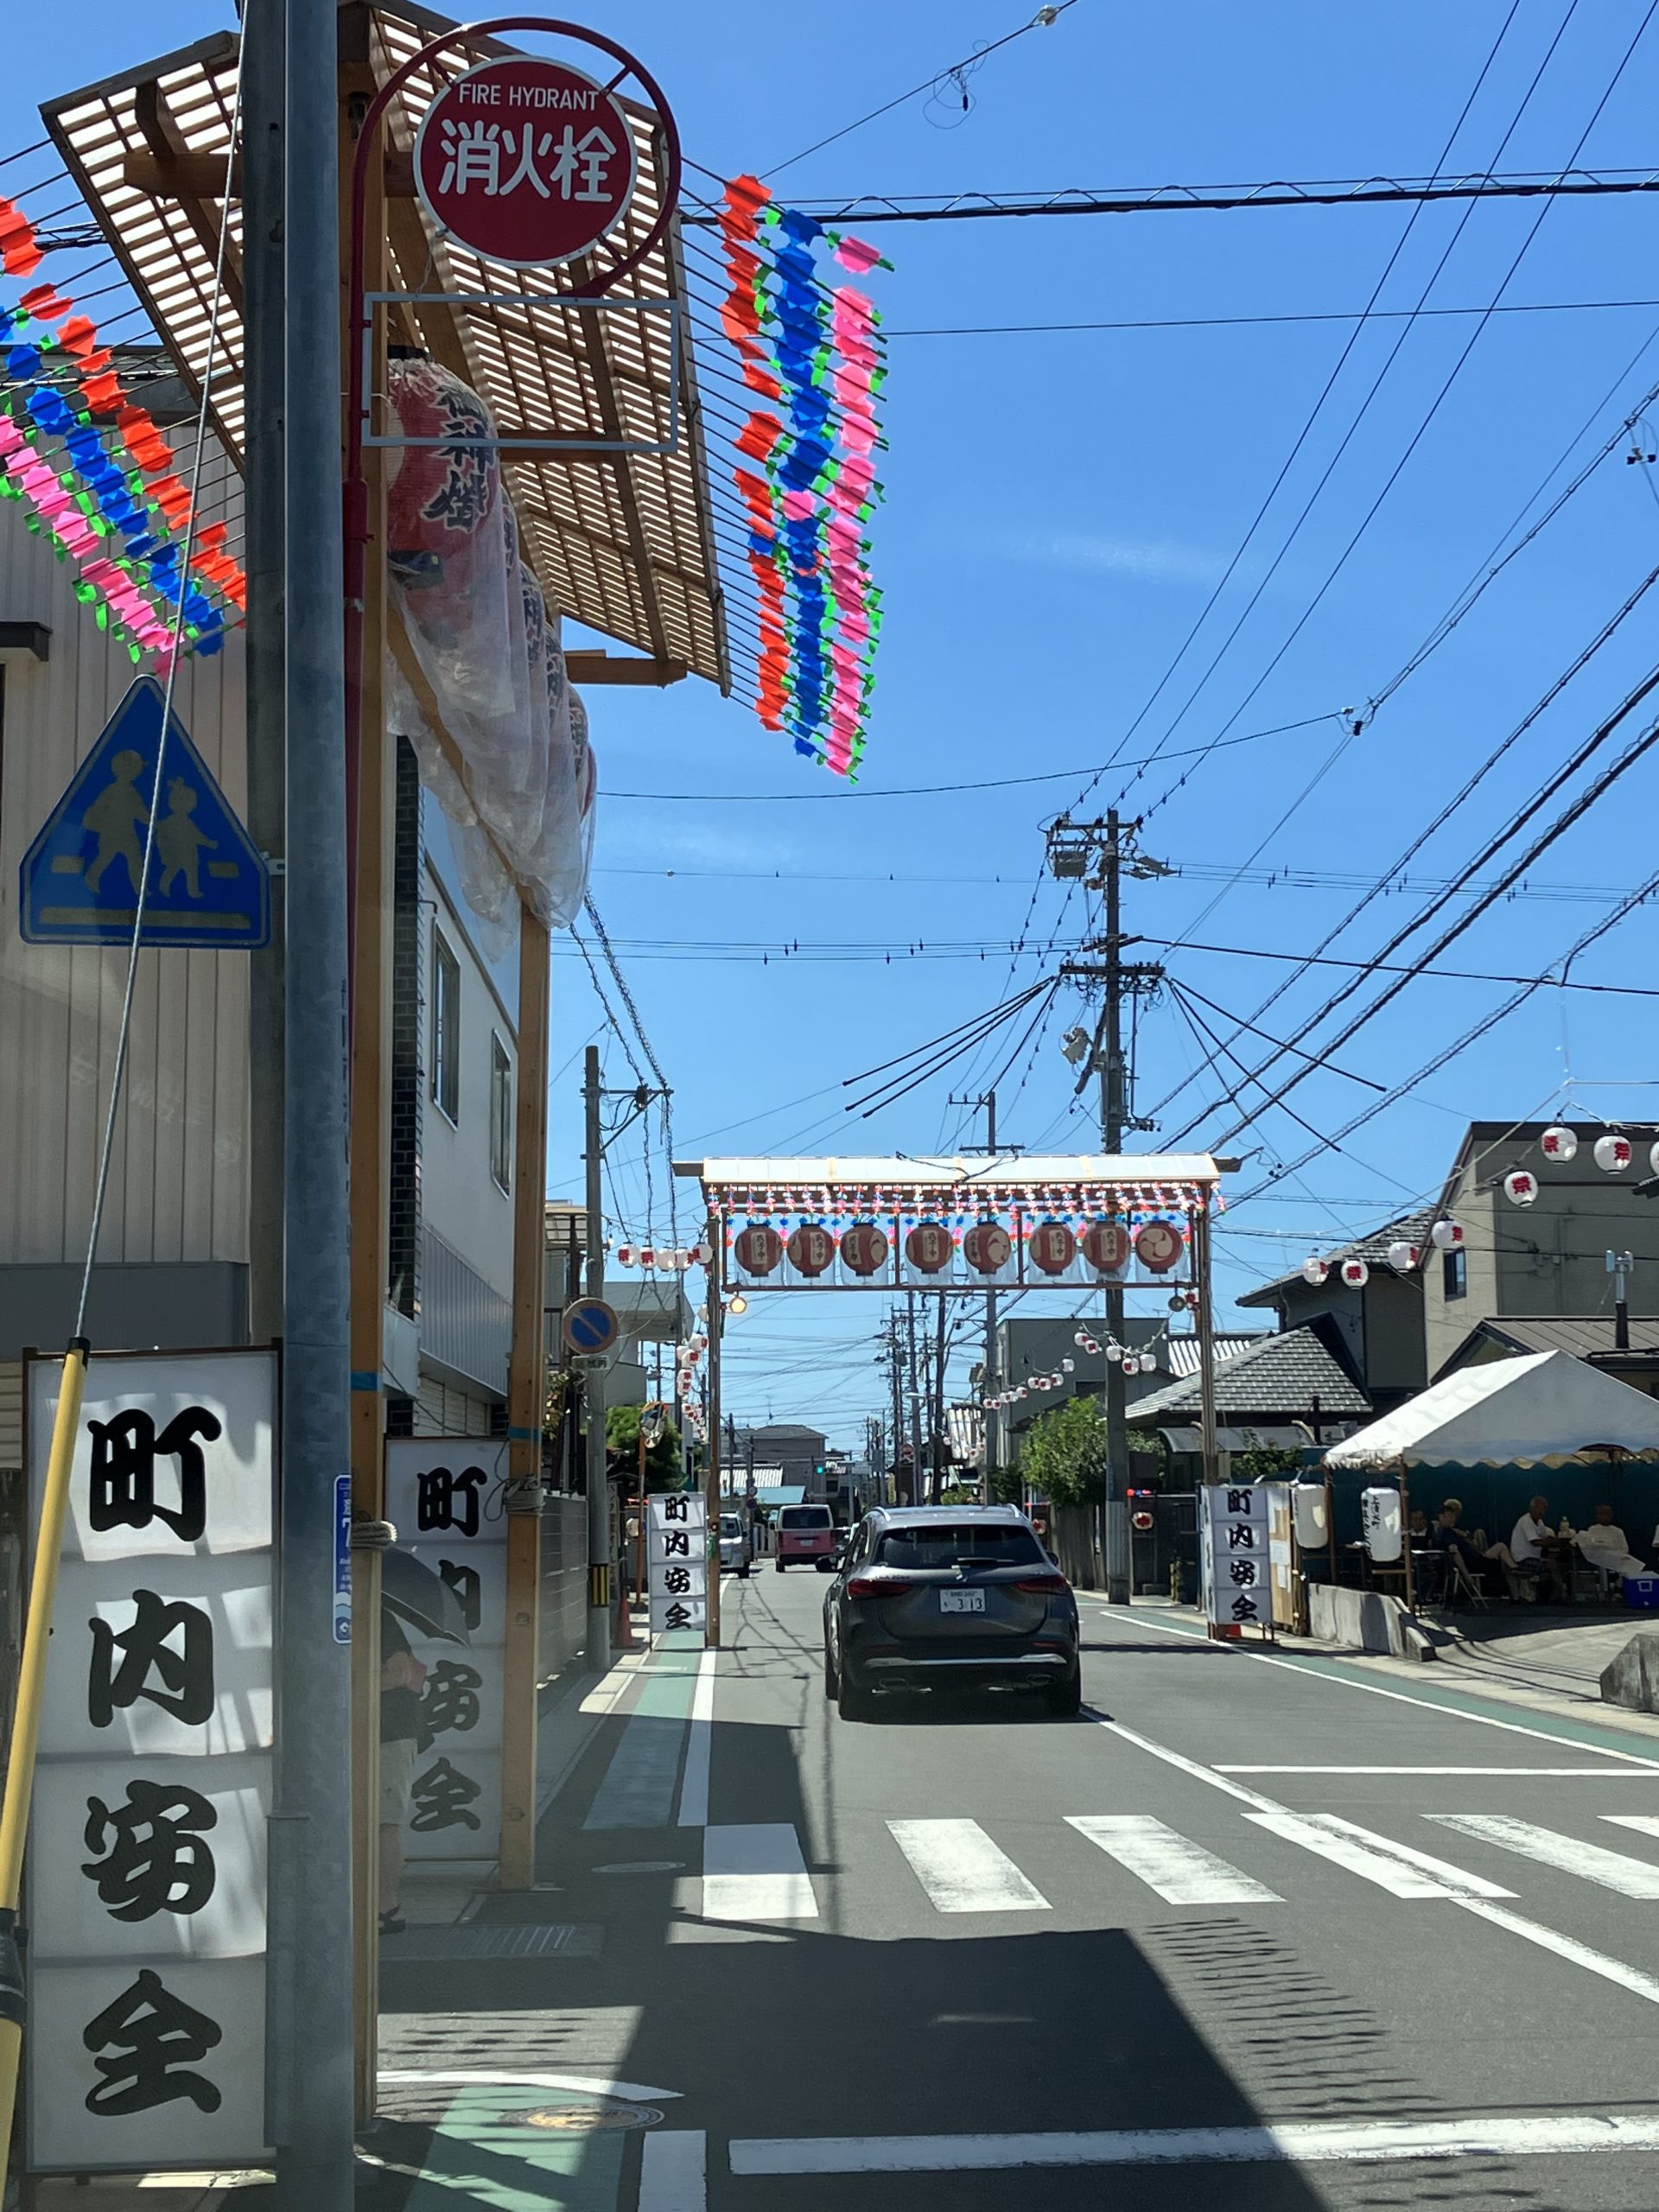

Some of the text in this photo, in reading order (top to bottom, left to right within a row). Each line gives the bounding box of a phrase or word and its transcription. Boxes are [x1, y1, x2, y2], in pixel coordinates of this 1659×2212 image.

[438, 119, 617, 202] 消火栓
[459, 83, 600, 111] FIRE HYDRANT
[664, 1496, 691, 1630] 町内安全
[1227, 1488, 1258, 1622] 町内安全
[82, 1407, 222, 2116] 町内安全
